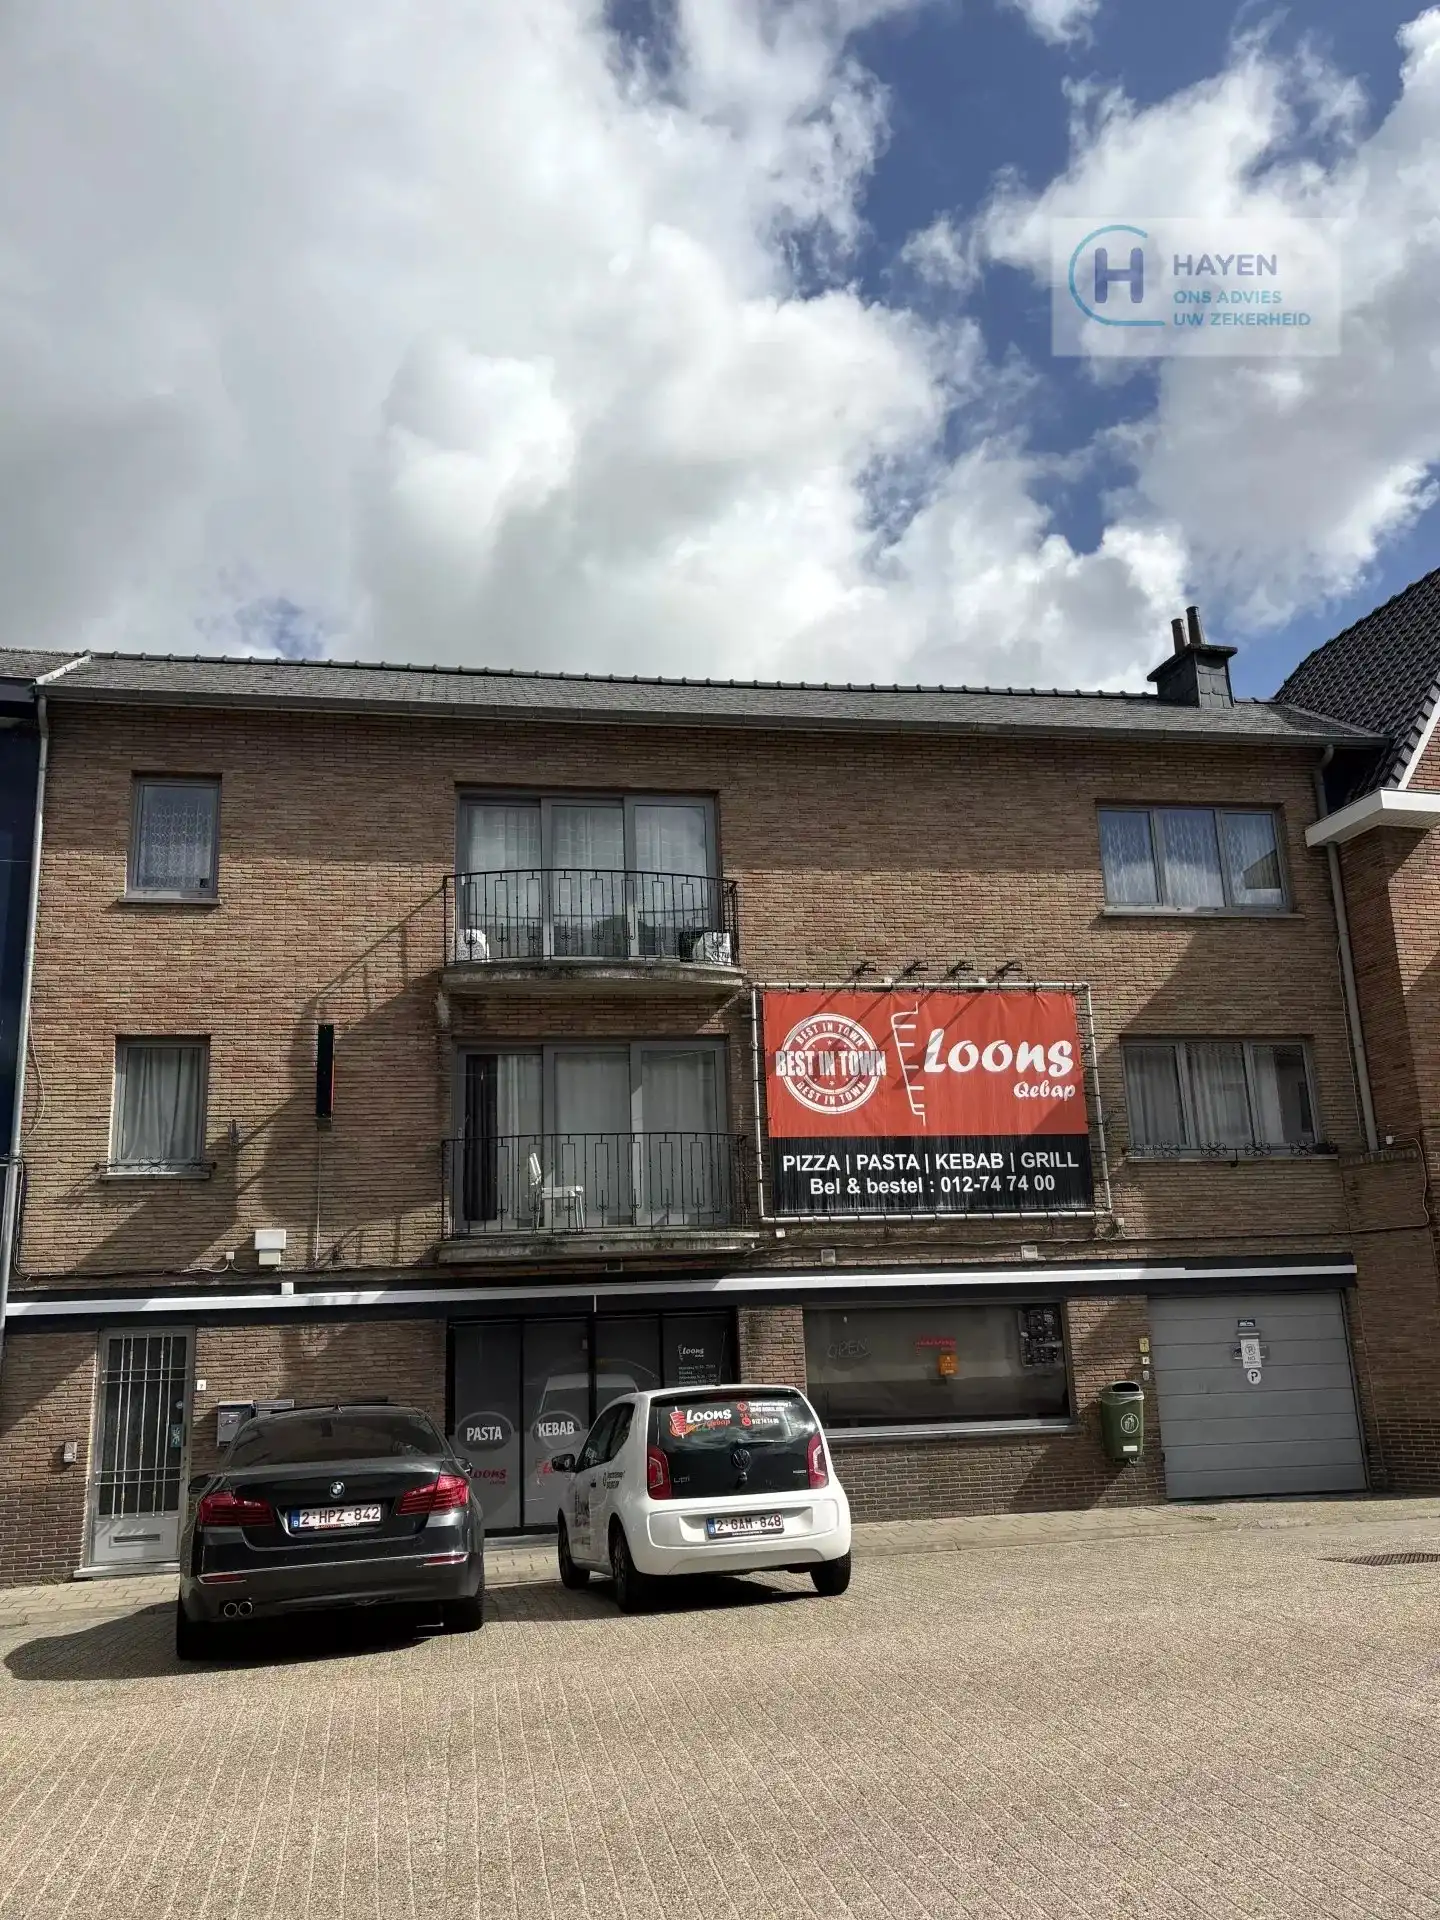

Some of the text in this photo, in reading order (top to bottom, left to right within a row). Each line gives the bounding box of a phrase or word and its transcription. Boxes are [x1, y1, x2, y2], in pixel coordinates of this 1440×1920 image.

[795, 1022, 865, 1047] BEST IN TOWN
[775, 1050, 887, 1076] BEST IN TOWN
[923, 1028, 1074, 1077] Loons
[796, 1081, 867, 1105] BEST IN TOWN
[1013, 1079, 1076, 1101] Qebap
[783, 1154, 840, 1172] PIZZA
[856, 1153, 920, 1171] PASTA
[935, 1152, 1004, 1170] KEBAB
[1021, 1151, 1079, 1168] GRILL
[810, 1178, 840, 1195] Bel
[846, 1177, 861, 1194] &
[867, 1176, 923, 1194] bestel
[940, 1175, 1001, 1192] 012-74
[1006, 1175, 1029, 1192] 74
[1034, 1174, 1055, 1191] 00
[827, 1339, 868, 1359] OPEN
[686, 1409, 732, 1423] Loons
[466, 1426, 503, 1441] PASTA
[538, 1421, 575, 1437] KEBAB
[301, 1506, 380, 1525] 2-HPZ-842
[717, 1514, 781, 1532] 2-GAM-848
